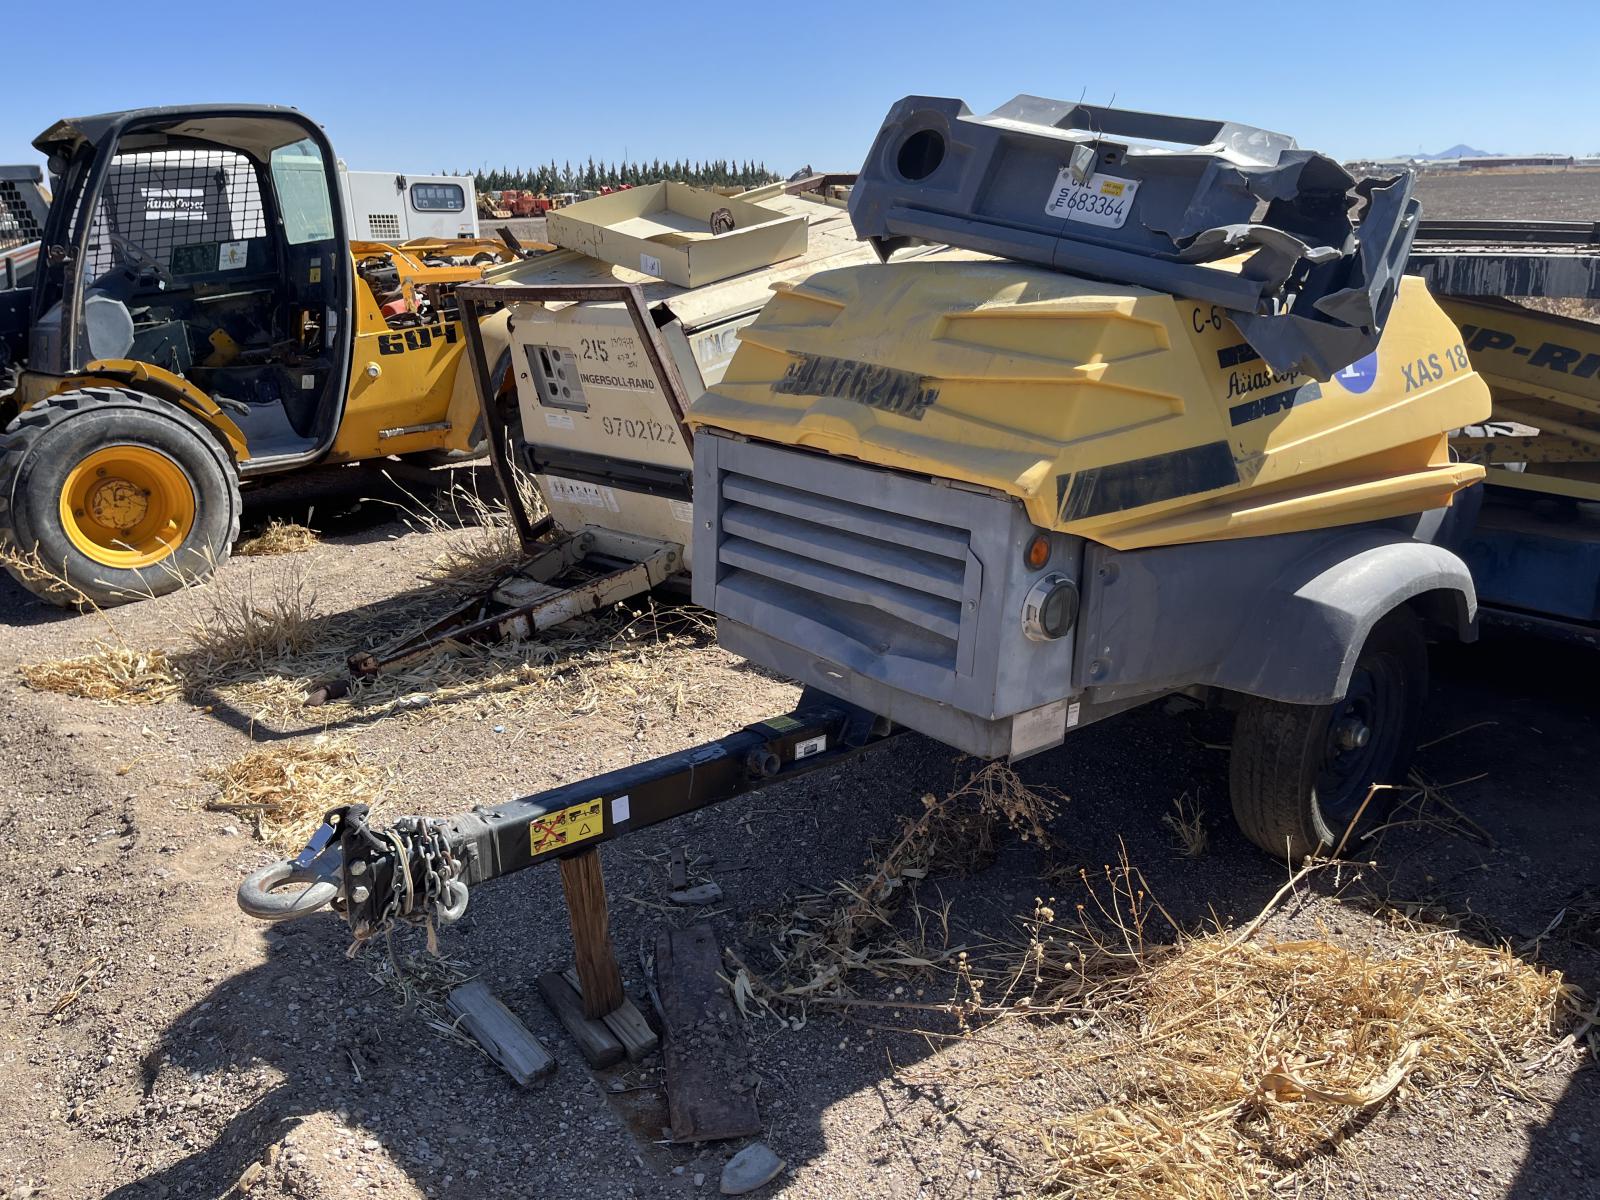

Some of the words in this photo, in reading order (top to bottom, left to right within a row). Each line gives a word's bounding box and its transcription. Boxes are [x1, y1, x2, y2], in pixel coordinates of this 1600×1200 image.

[1067, 192, 1125, 217] 683364
[1193, 305, 1221, 333] C-6
[378, 324, 457, 355] 604
[580, 373, 655, 389] INGERSOLL-RAND
[1401, 353, 1443, 392] XAS
